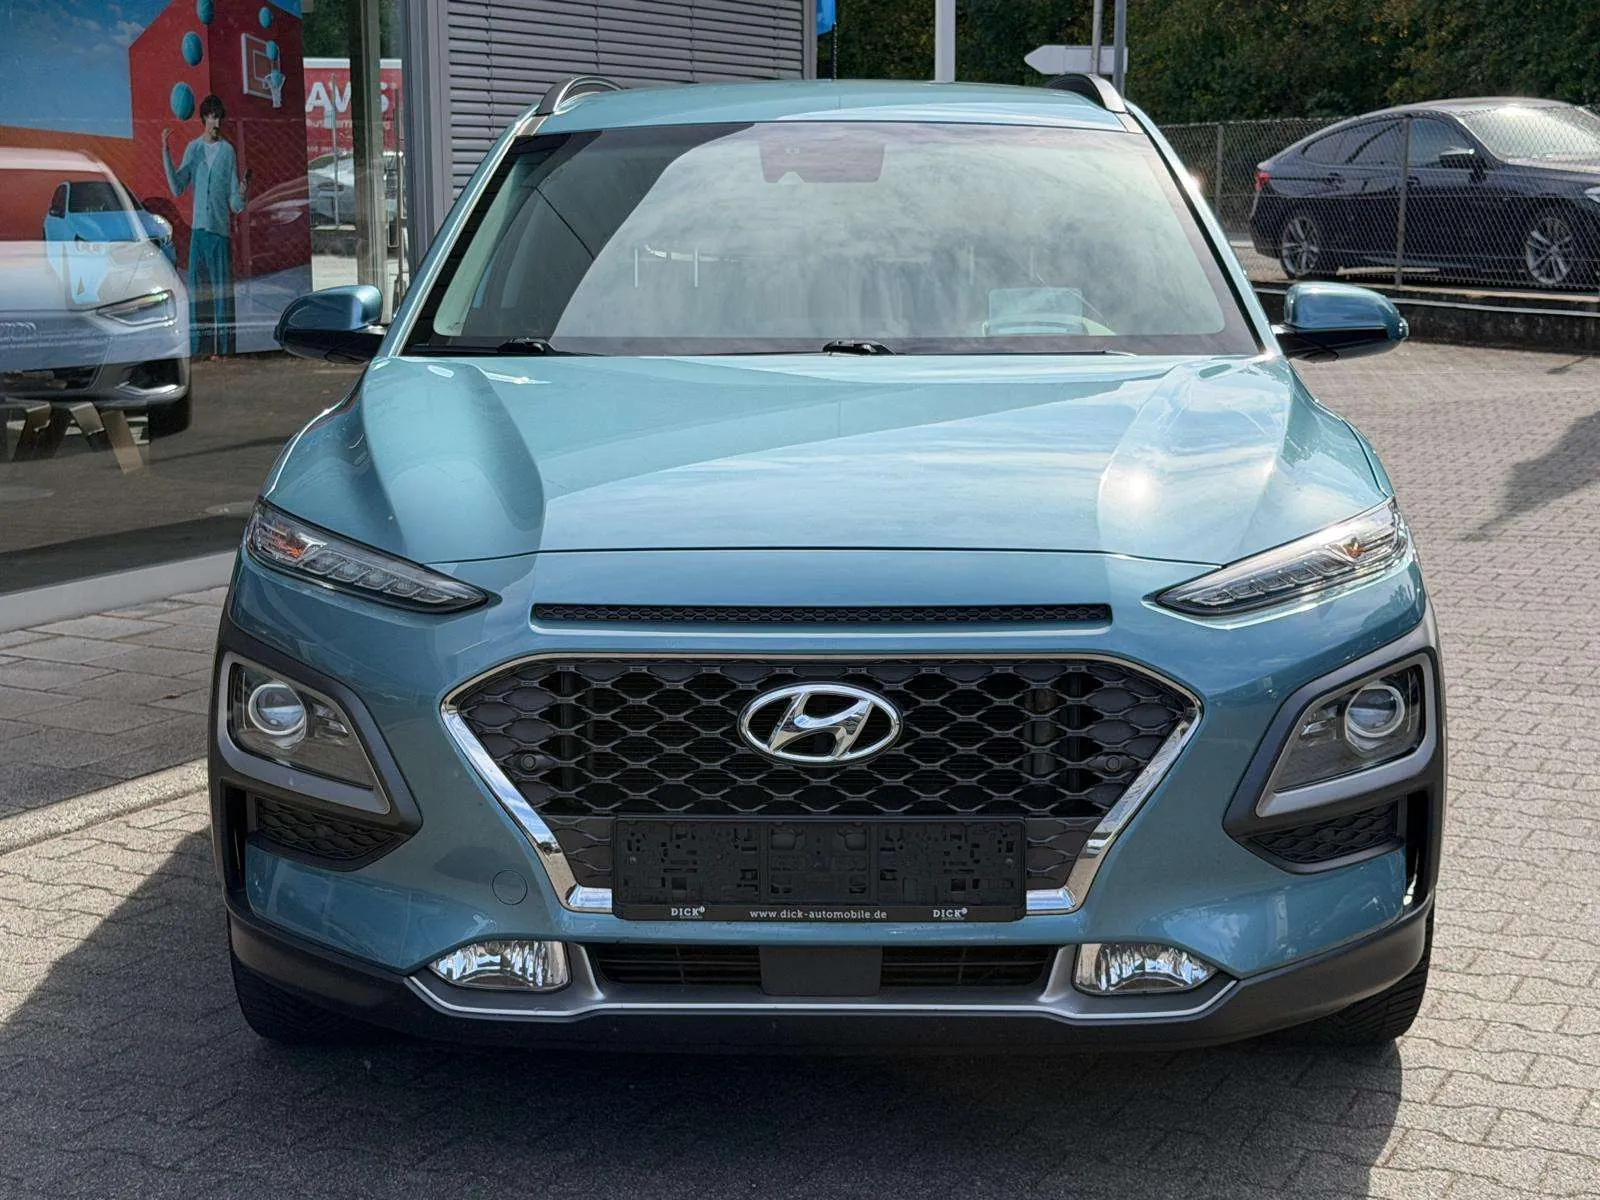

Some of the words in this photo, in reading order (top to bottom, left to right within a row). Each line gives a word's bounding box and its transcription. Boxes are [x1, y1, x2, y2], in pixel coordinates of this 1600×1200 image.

[305, 82, 389, 113] AVS
[671, 907, 699, 916] DICK
[749, 909, 887, 919] www.dick-automobile.de
[933, 909, 962, 918] DICK
